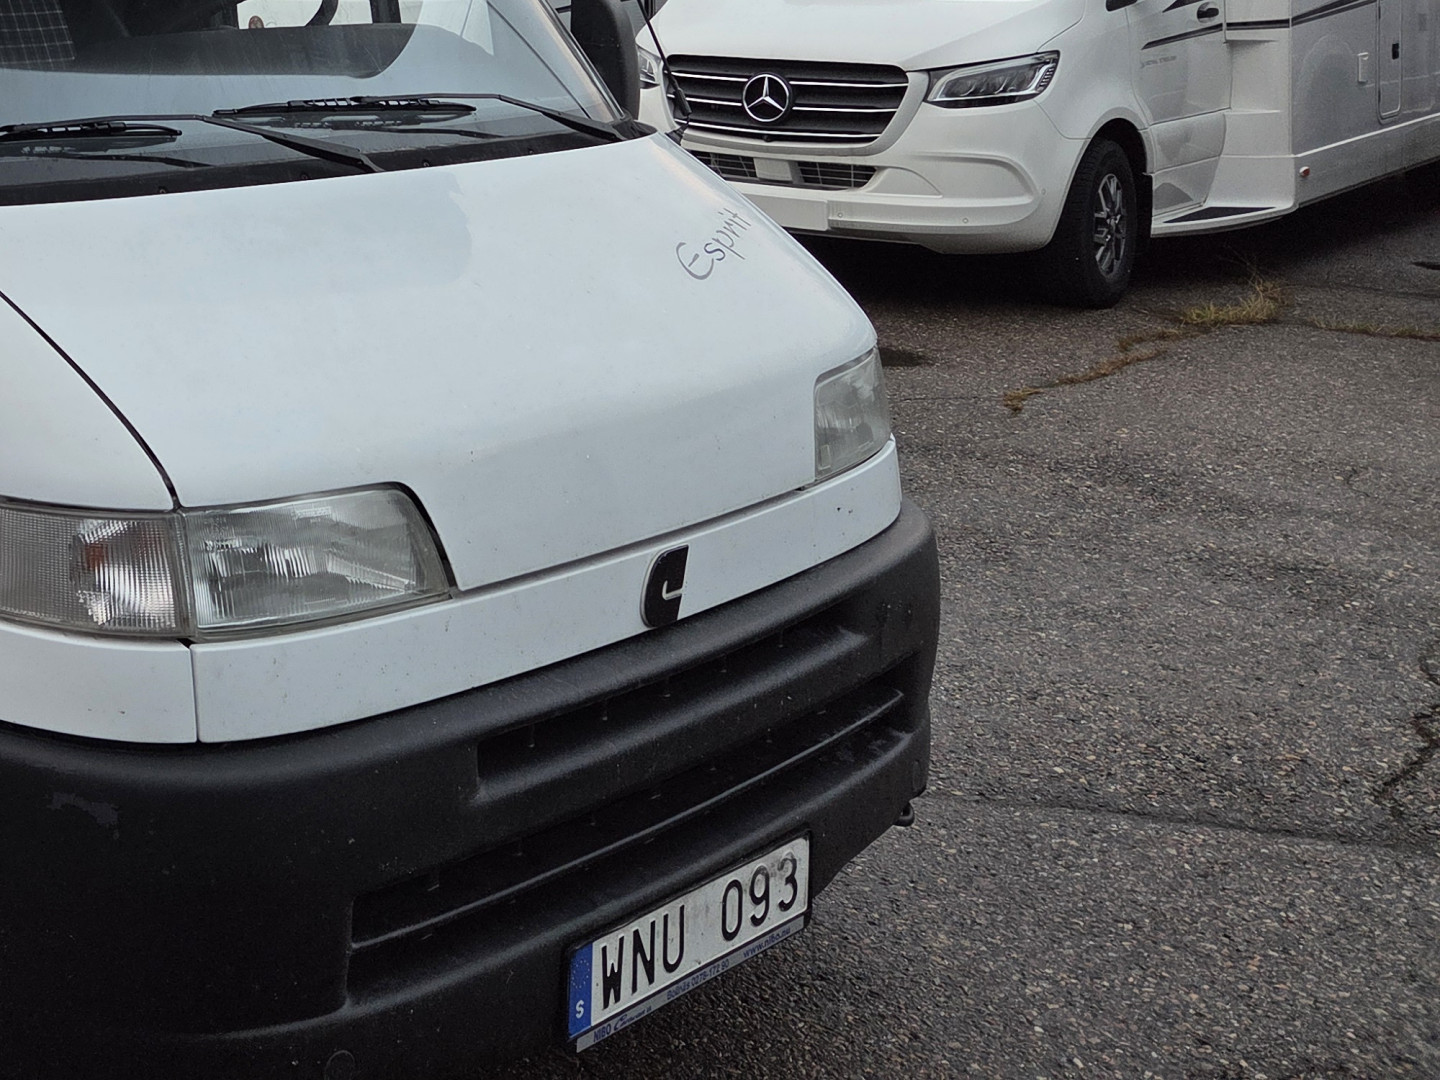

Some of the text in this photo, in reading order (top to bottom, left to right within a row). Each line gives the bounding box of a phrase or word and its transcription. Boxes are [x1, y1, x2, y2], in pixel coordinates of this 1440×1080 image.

[676, 208, 751, 280] Esprit
[601, 854, 798, 1010] WNU 093
[575, 999, 585, 1019] S
